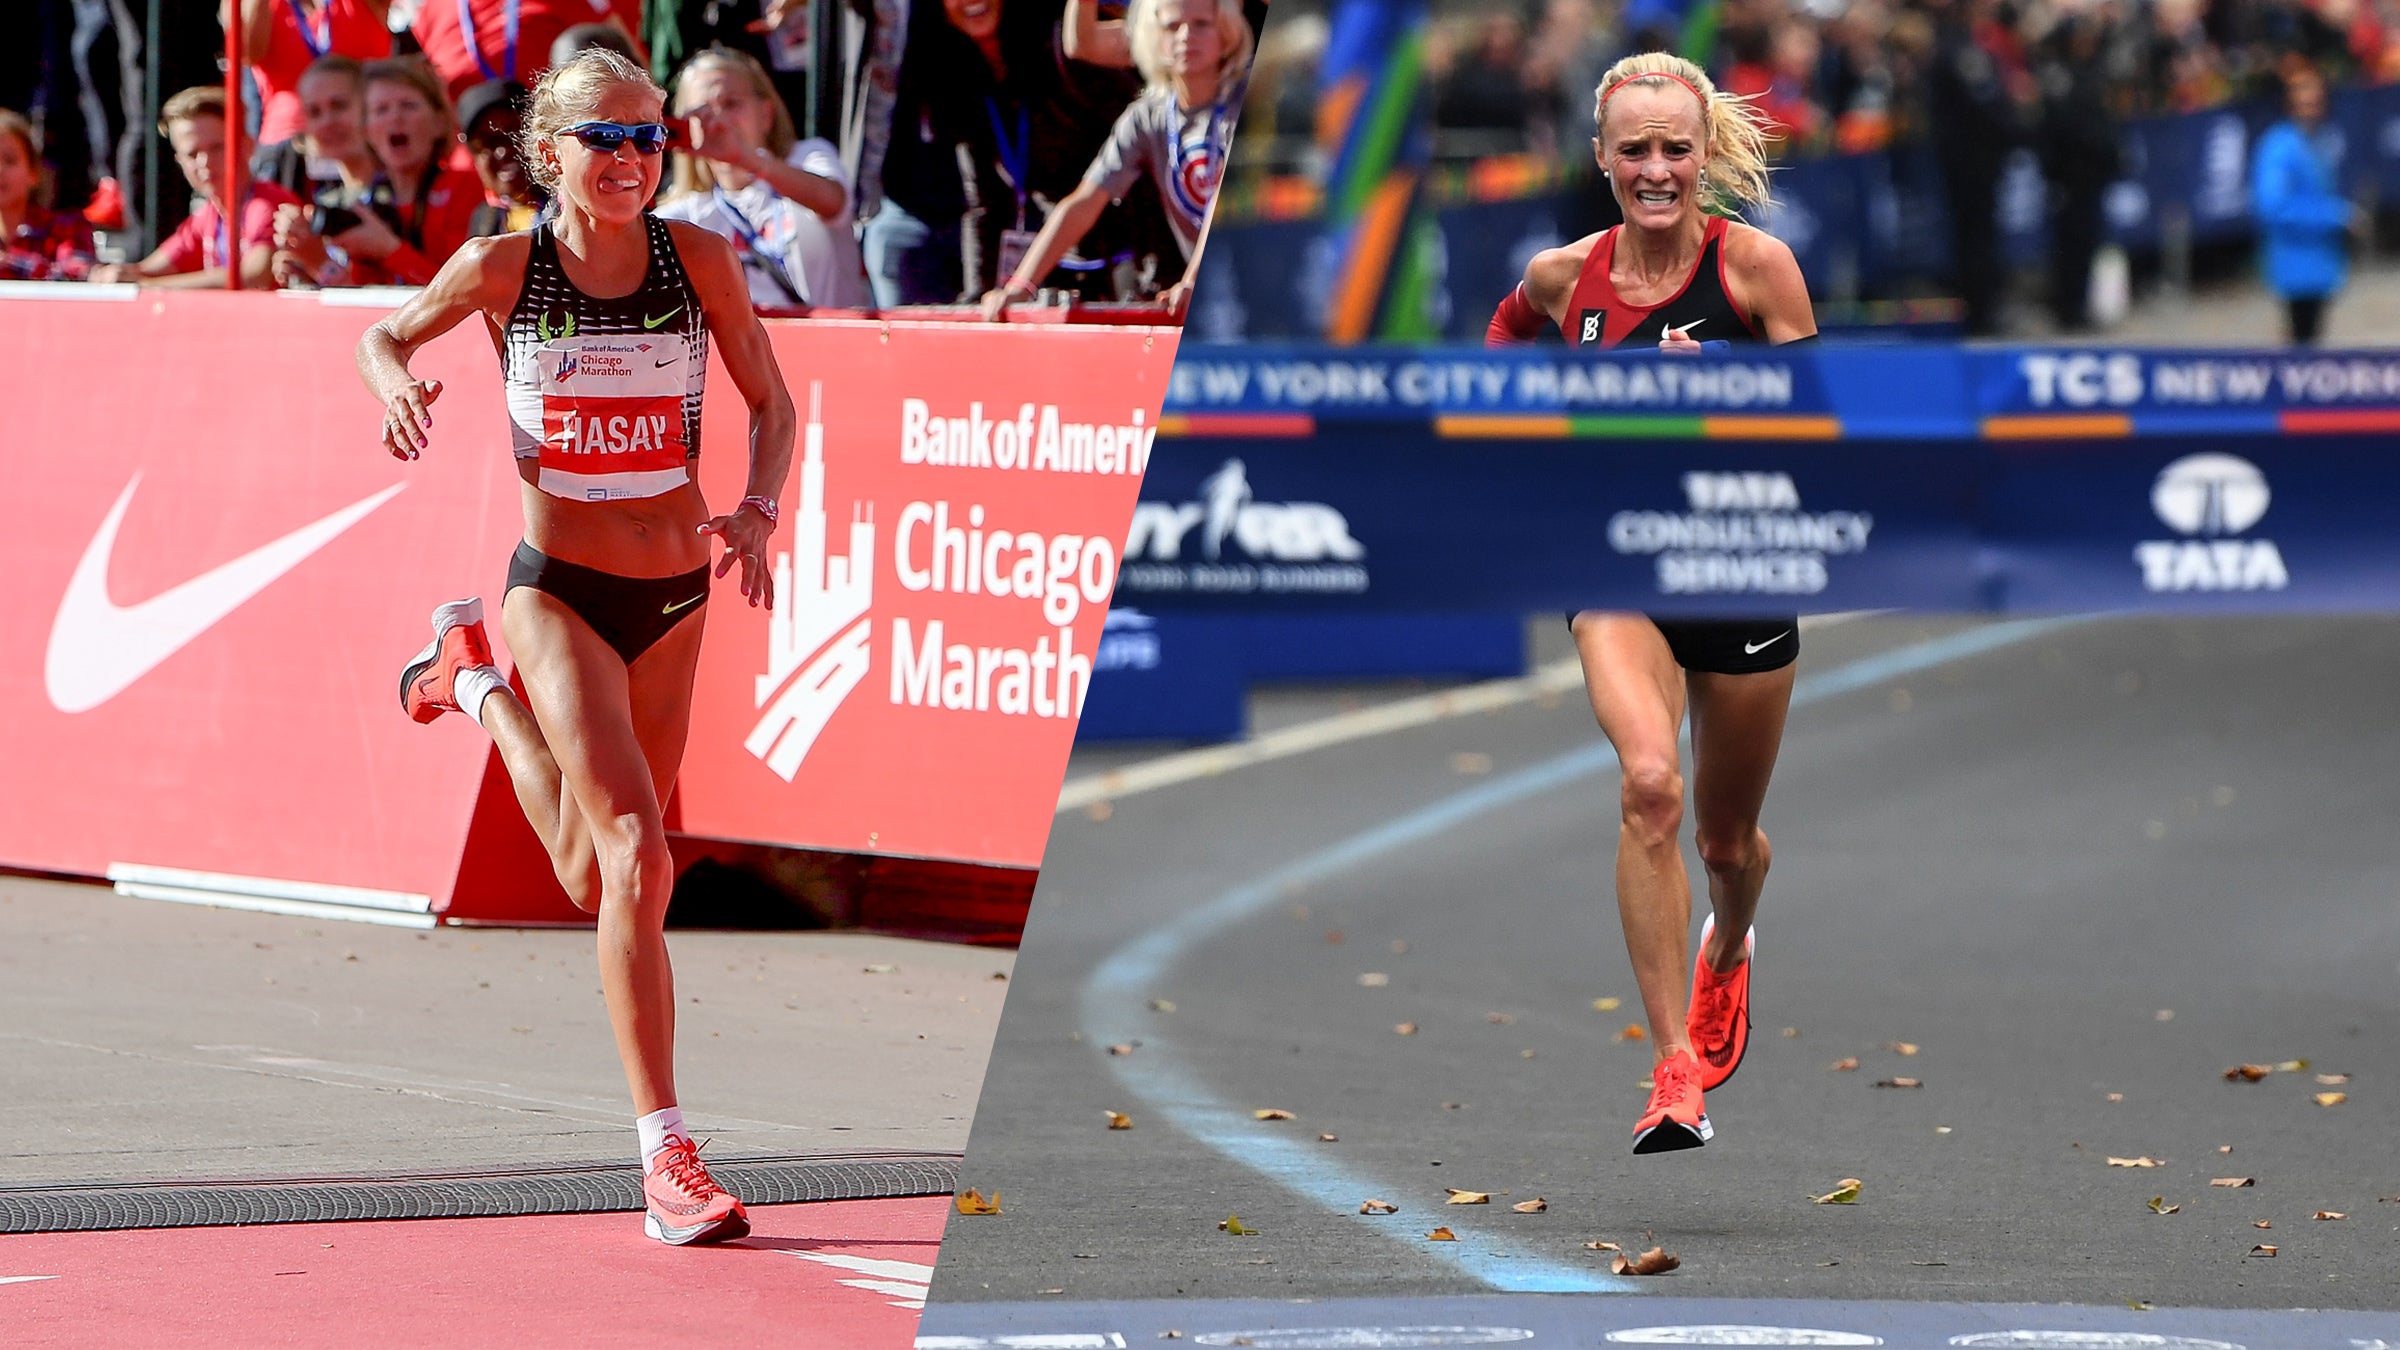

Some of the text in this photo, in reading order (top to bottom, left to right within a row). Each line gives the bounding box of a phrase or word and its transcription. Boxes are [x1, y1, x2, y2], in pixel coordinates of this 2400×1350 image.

[581, 355, 622, 367] Chicago
[606, 345, 634, 353] America
[581, 366, 632, 377] Marathon
[1256, 360, 1393, 405] YORK
[1395, 360, 1509, 405] CITY
[1518, 360, 1791, 406] MARATHON
[2022, 354, 2144, 406] TCS
[2152, 361, 2272, 404] NEW
[562, 415, 666, 454] HASAY
[901, 398, 993, 467] Bank
[993, 402, 1036, 470] of
[1683, 470, 1799, 510] TATA
[1607, 510, 1873, 554] CONSULTANCY
[895, 500, 1115, 627] Chicago
[1260, 562, 1370, 592] RUNNERS
[1654, 551, 1828, 594] SERVICES
[2133, 539, 2290, 591] TATA
[890, 617, 1092, 719] Marath
